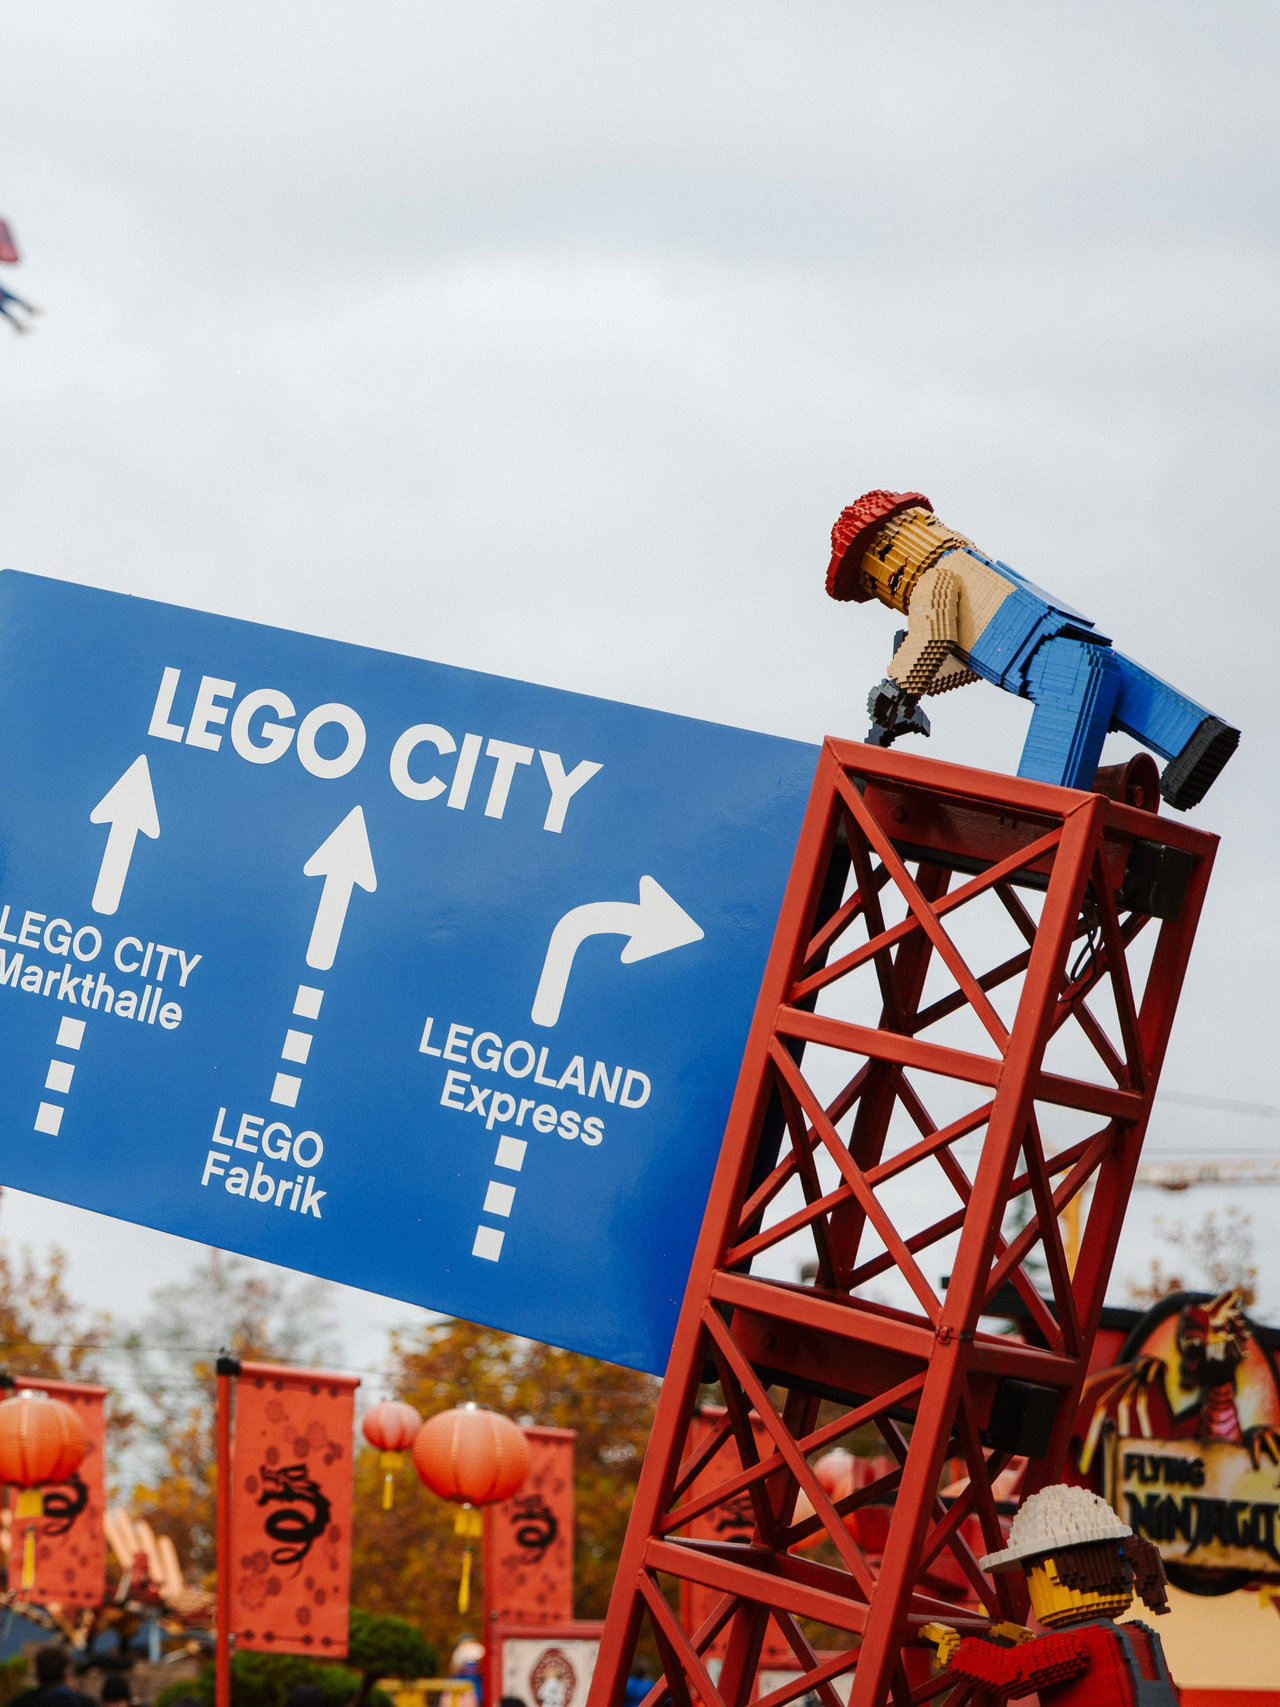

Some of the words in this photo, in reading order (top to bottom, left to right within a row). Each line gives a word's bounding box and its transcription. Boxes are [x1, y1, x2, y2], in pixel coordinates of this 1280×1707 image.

[147, 666, 367, 780] LEGO
[389, 723, 605, 834] CITY
[114, 936, 203, 988] CITY
[418, 1016, 651, 1109] LEGOLAND
[211, 1106, 324, 1168] LEGO
[439, 1069, 605, 1146] Express
[201, 1149, 327, 1219] Fabrik
[1124, 1453, 1206, 1488] FLYING
[1124, 1491, 1280, 1561] NINJAGO
